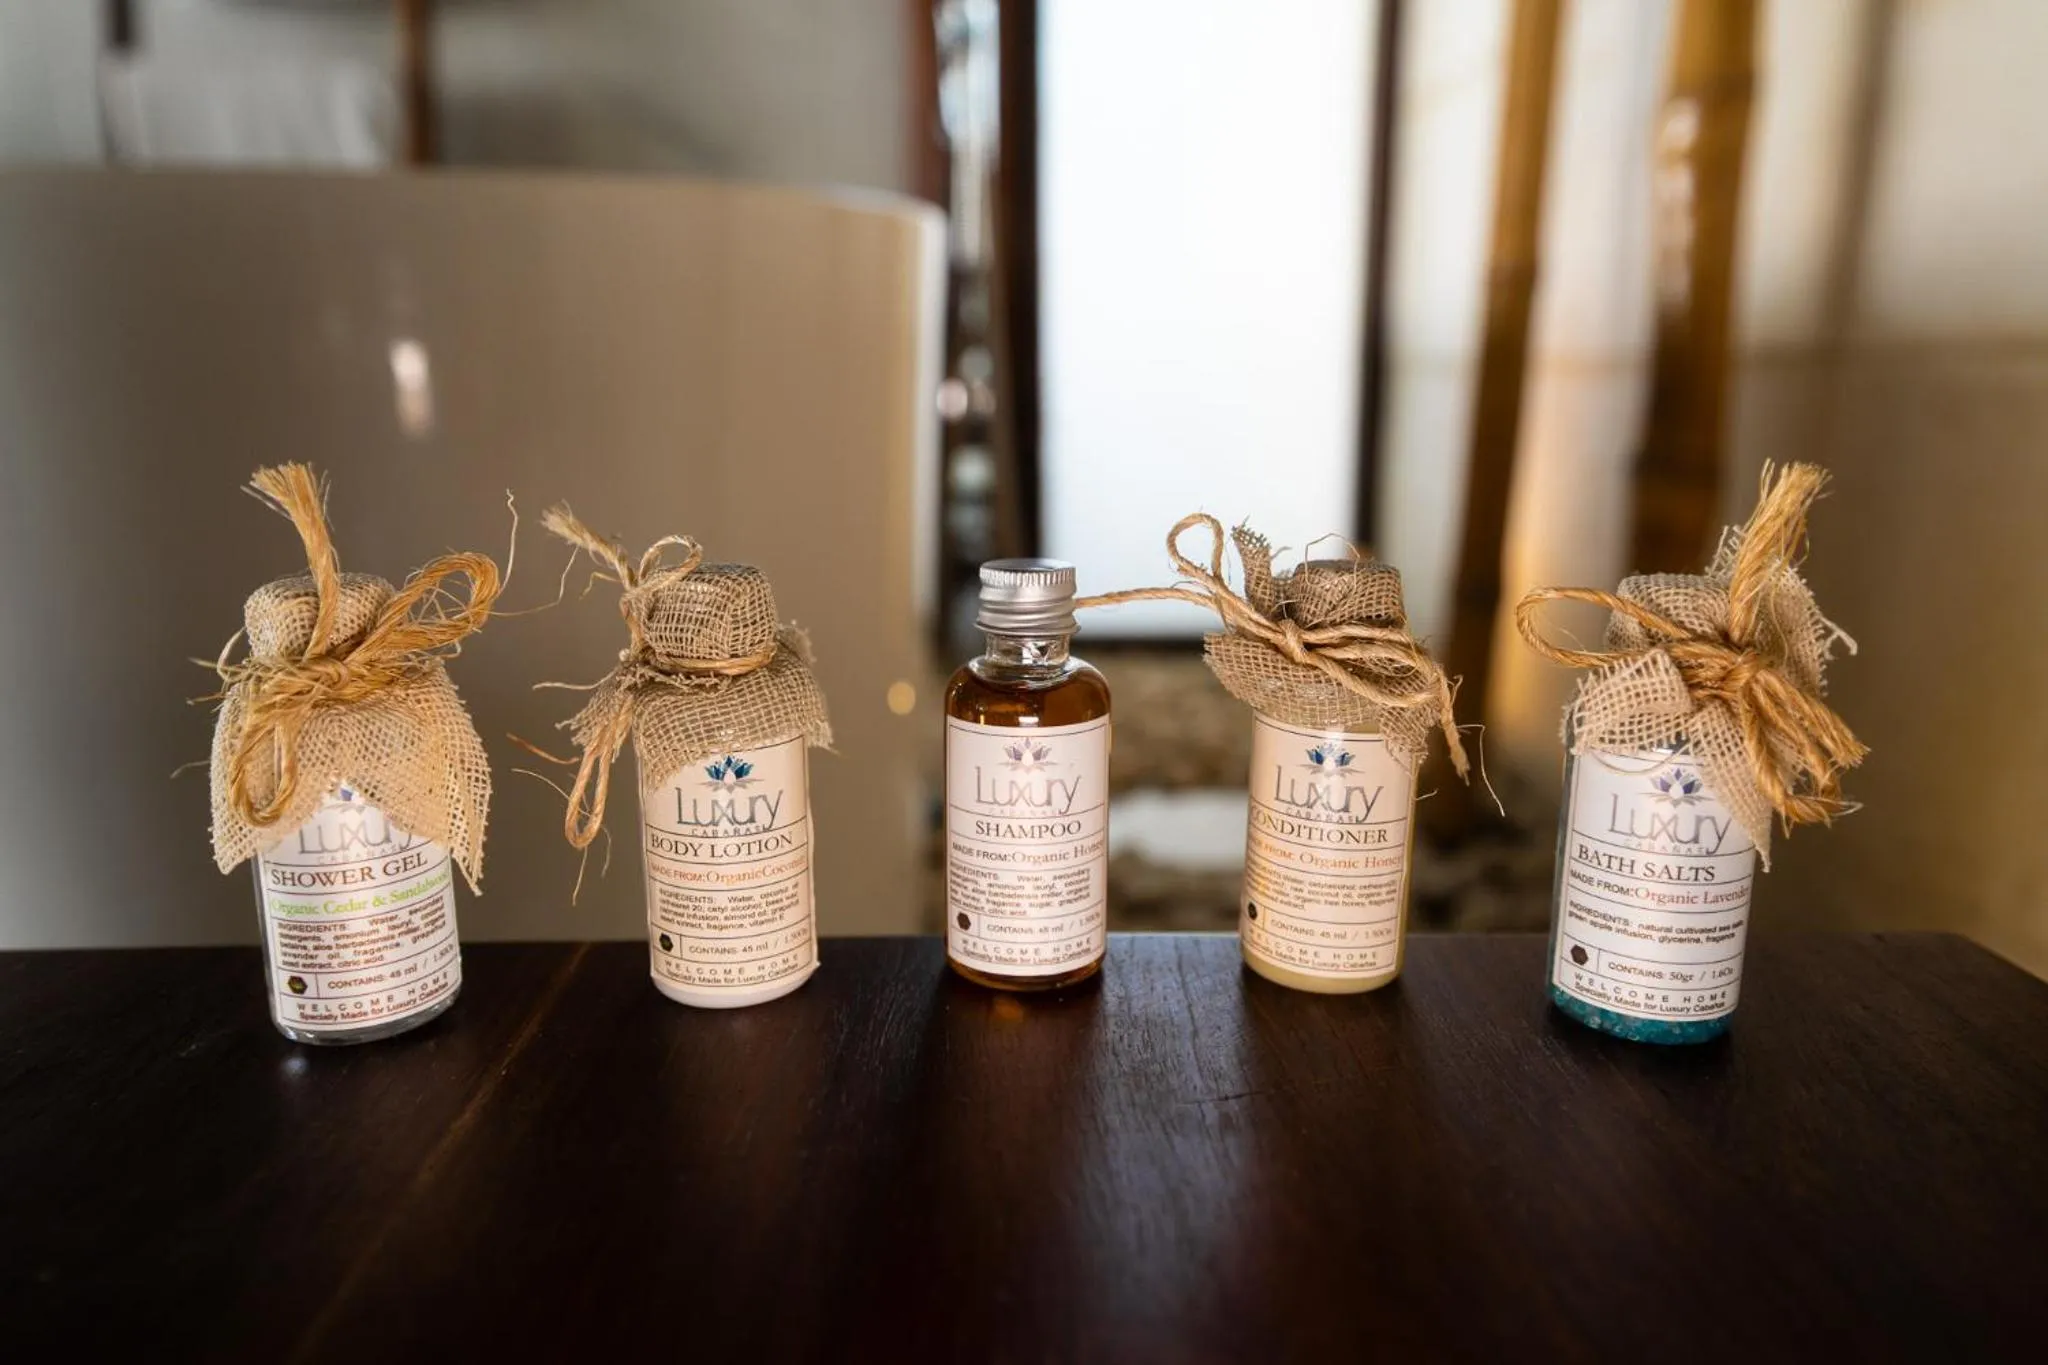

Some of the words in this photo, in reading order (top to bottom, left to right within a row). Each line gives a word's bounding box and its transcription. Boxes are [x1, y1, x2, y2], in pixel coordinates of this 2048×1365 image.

[975, 766, 1082, 815] Luxury
[1274, 765, 1384, 823] Luxury
[675, 787, 784, 830] Luxury
[975, 820, 1082, 839] SHAMPOO
[1608, 793, 1733, 855] Luxury
[651, 834, 703, 857] BODY
[711, 832, 793, 858] LOTION
[271, 866, 376, 888] SHOWER
[383, 852, 428, 877] GEL
[1013, 851, 1069, 866] Organic
[1300, 852, 1360, 870] Organic
[1577, 844, 1635, 874] BATH
[1643, 861, 1716, 881] SALTS
[1570, 870, 1594, 887] MADE
[1635, 887, 1699, 905] Organic
[271, 900, 320, 917] Organic
[323, 899, 367, 914] Cedar
[372, 894, 387, 908] &
[1638, 922, 1673, 933] natural
[664, 959, 745, 975] WELCOME
[757, 954, 799, 971] HOME
[1668, 970, 1694, 985] 50gr
[297, 993, 394, 1011] WELCOME
[408, 971, 448, 996] HOME
[1575, 972, 1669, 1003] WELCOME
[1683, 991, 1727, 1003] HOME
[341, 1009, 368, 1020] Made
[371, 1005, 385, 1015] for
[387, 996, 417, 1013] Luxury
[1614, 996, 1641, 1009] Made
[1643, 999, 1657, 1010] for
[1660, 1000, 1691, 1014] Luxury
